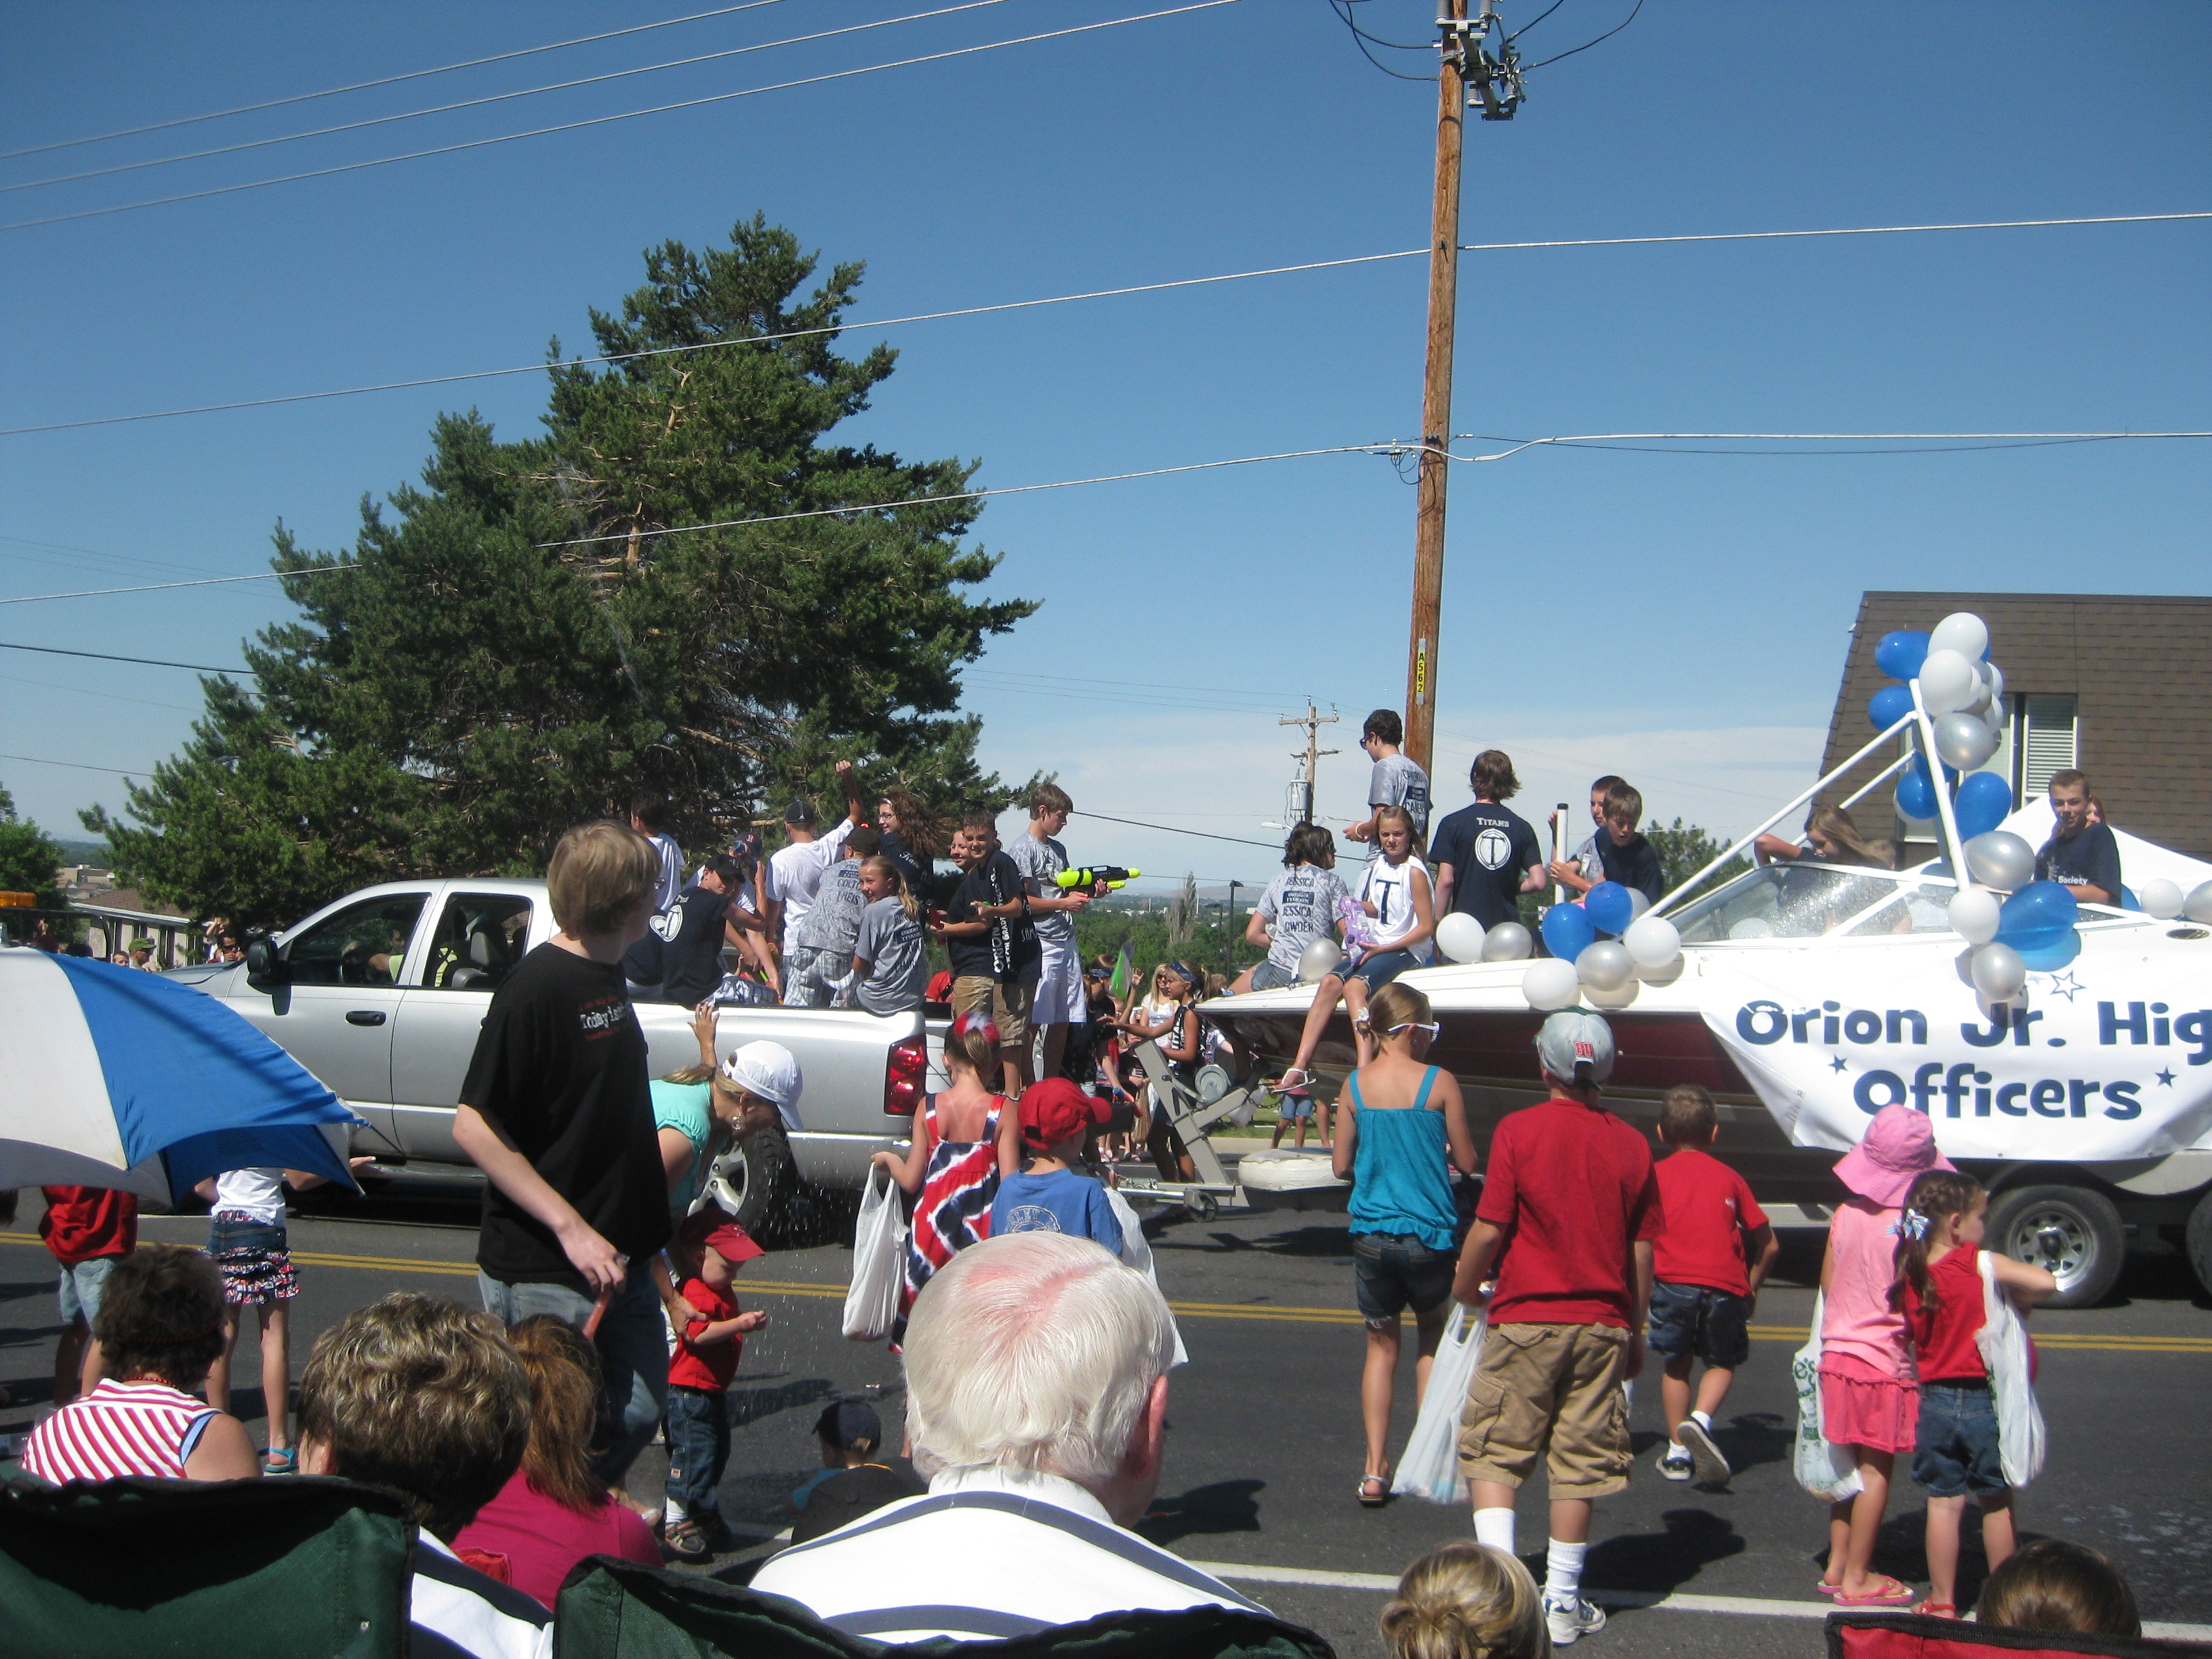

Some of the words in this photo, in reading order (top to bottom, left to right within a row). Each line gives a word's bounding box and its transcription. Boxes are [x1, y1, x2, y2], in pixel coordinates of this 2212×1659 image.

[1475, 817, 1510, 828] TITANS
[1375, 878, 1401, 925] T
[2057, 875, 2089, 885] Society
[1282, 905, 1312, 918] JESSICA
[991, 927, 1004, 974] ORION
[1736, 1000, 1928, 1046] Orion
[1960, 1001, 2067, 1048] Jr.
[2097, 1000, 2212, 1066] Hig
[1853, 1062, 2143, 1120] Officers
